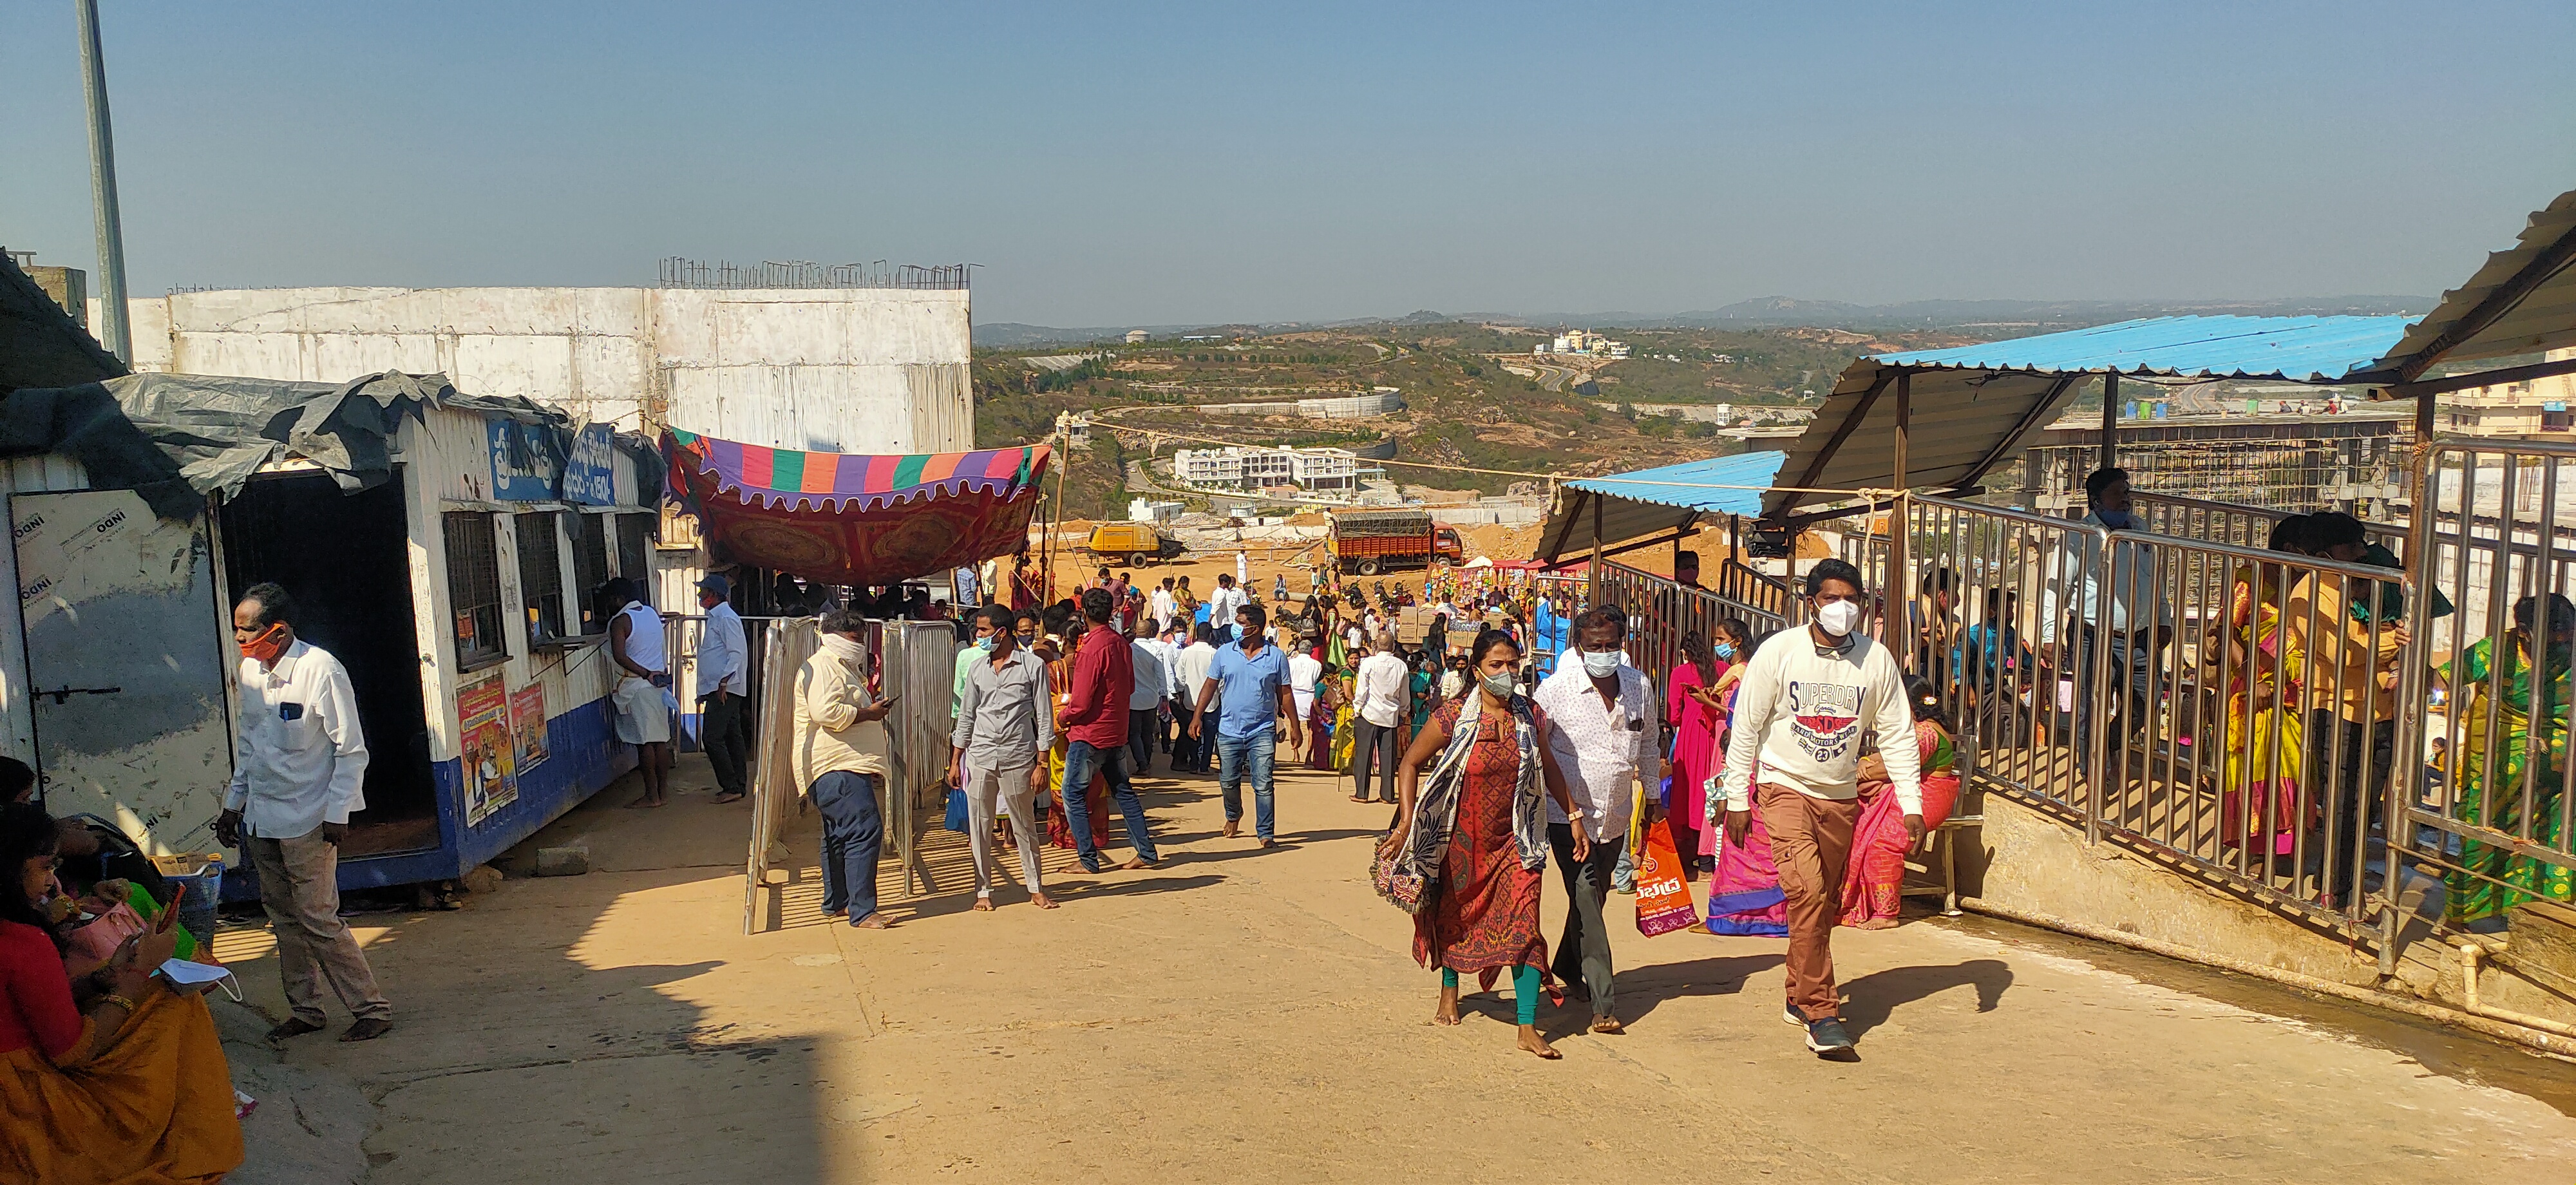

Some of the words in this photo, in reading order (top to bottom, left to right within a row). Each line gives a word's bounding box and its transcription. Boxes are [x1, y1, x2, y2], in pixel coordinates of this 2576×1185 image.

[97, 511, 126, 533] INDO
[1790, 681, 1866, 715] SUPERDRY
[1810, 737, 1839, 746] MOTORS
[1817, 751, 1828, 761] 23
